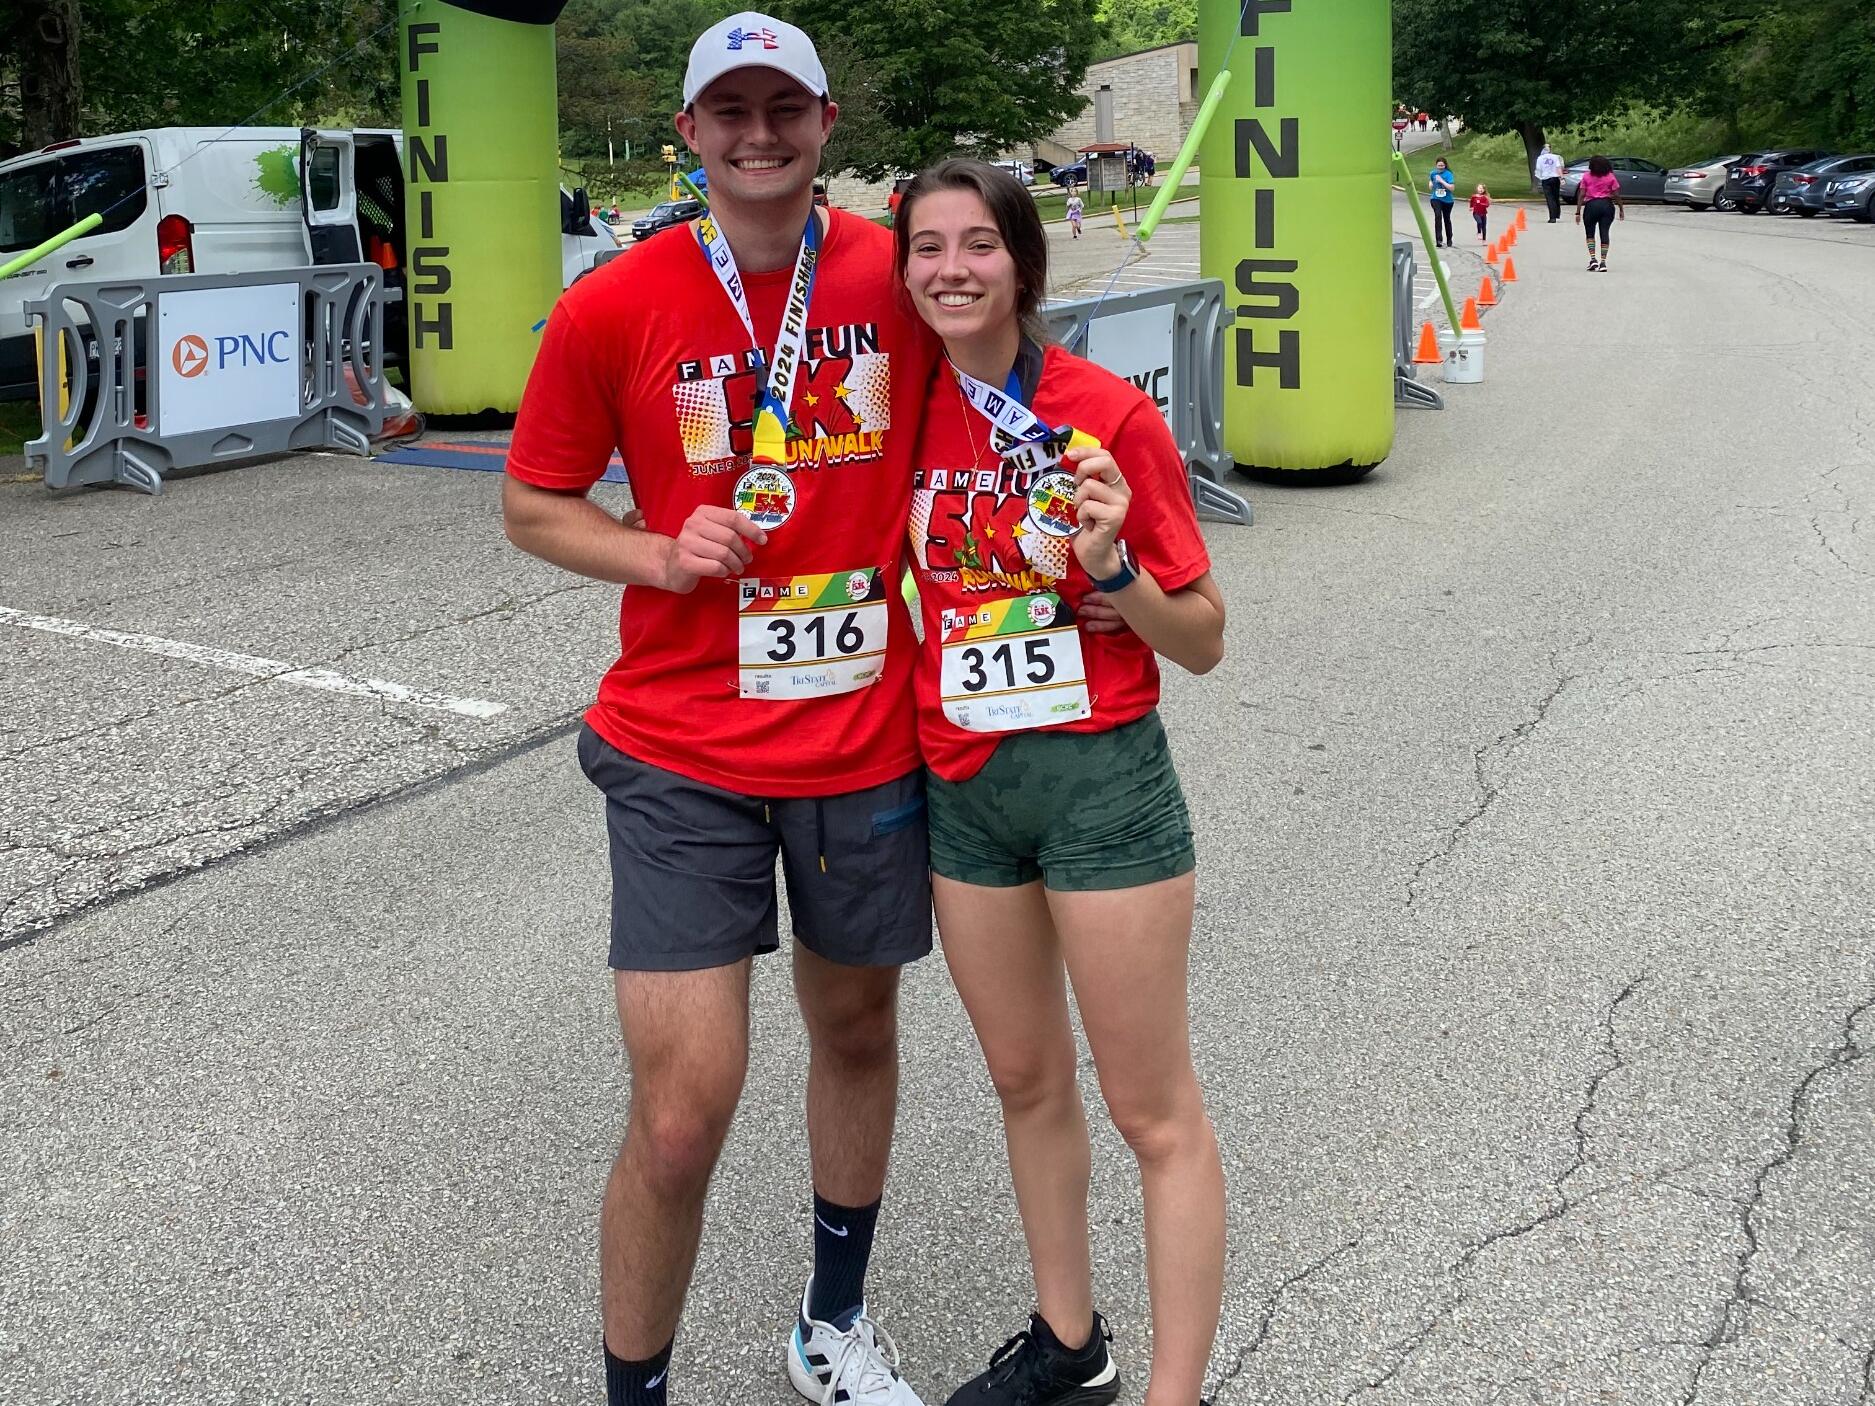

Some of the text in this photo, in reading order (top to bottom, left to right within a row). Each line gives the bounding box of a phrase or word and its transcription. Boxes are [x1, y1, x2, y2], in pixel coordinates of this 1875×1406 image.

[408, 23, 454, 350] FINISH
[1235, 0, 1300, 390] FINISH
[771, 245, 818, 403] 2024 FINISHER
[803, 323, 881, 361] FUN
[214, 330, 290, 370] PNC
[1123, 366, 1169, 408] YC
[692, 461, 725, 475] JUNE
[784, 429, 885, 474] UN/WALK
[743, 481, 790, 492] FAME
[756, 472, 777, 481] 2024
[914, 471, 995, 490] FAME
[1042, 480, 1075, 501] FAM
[925, 489, 1033, 573] 5K
[744, 585, 808, 598] FAME
[766, 611, 865, 662] 316
[944, 612, 991, 630] FAME
[961, 638, 1056, 692] 315
